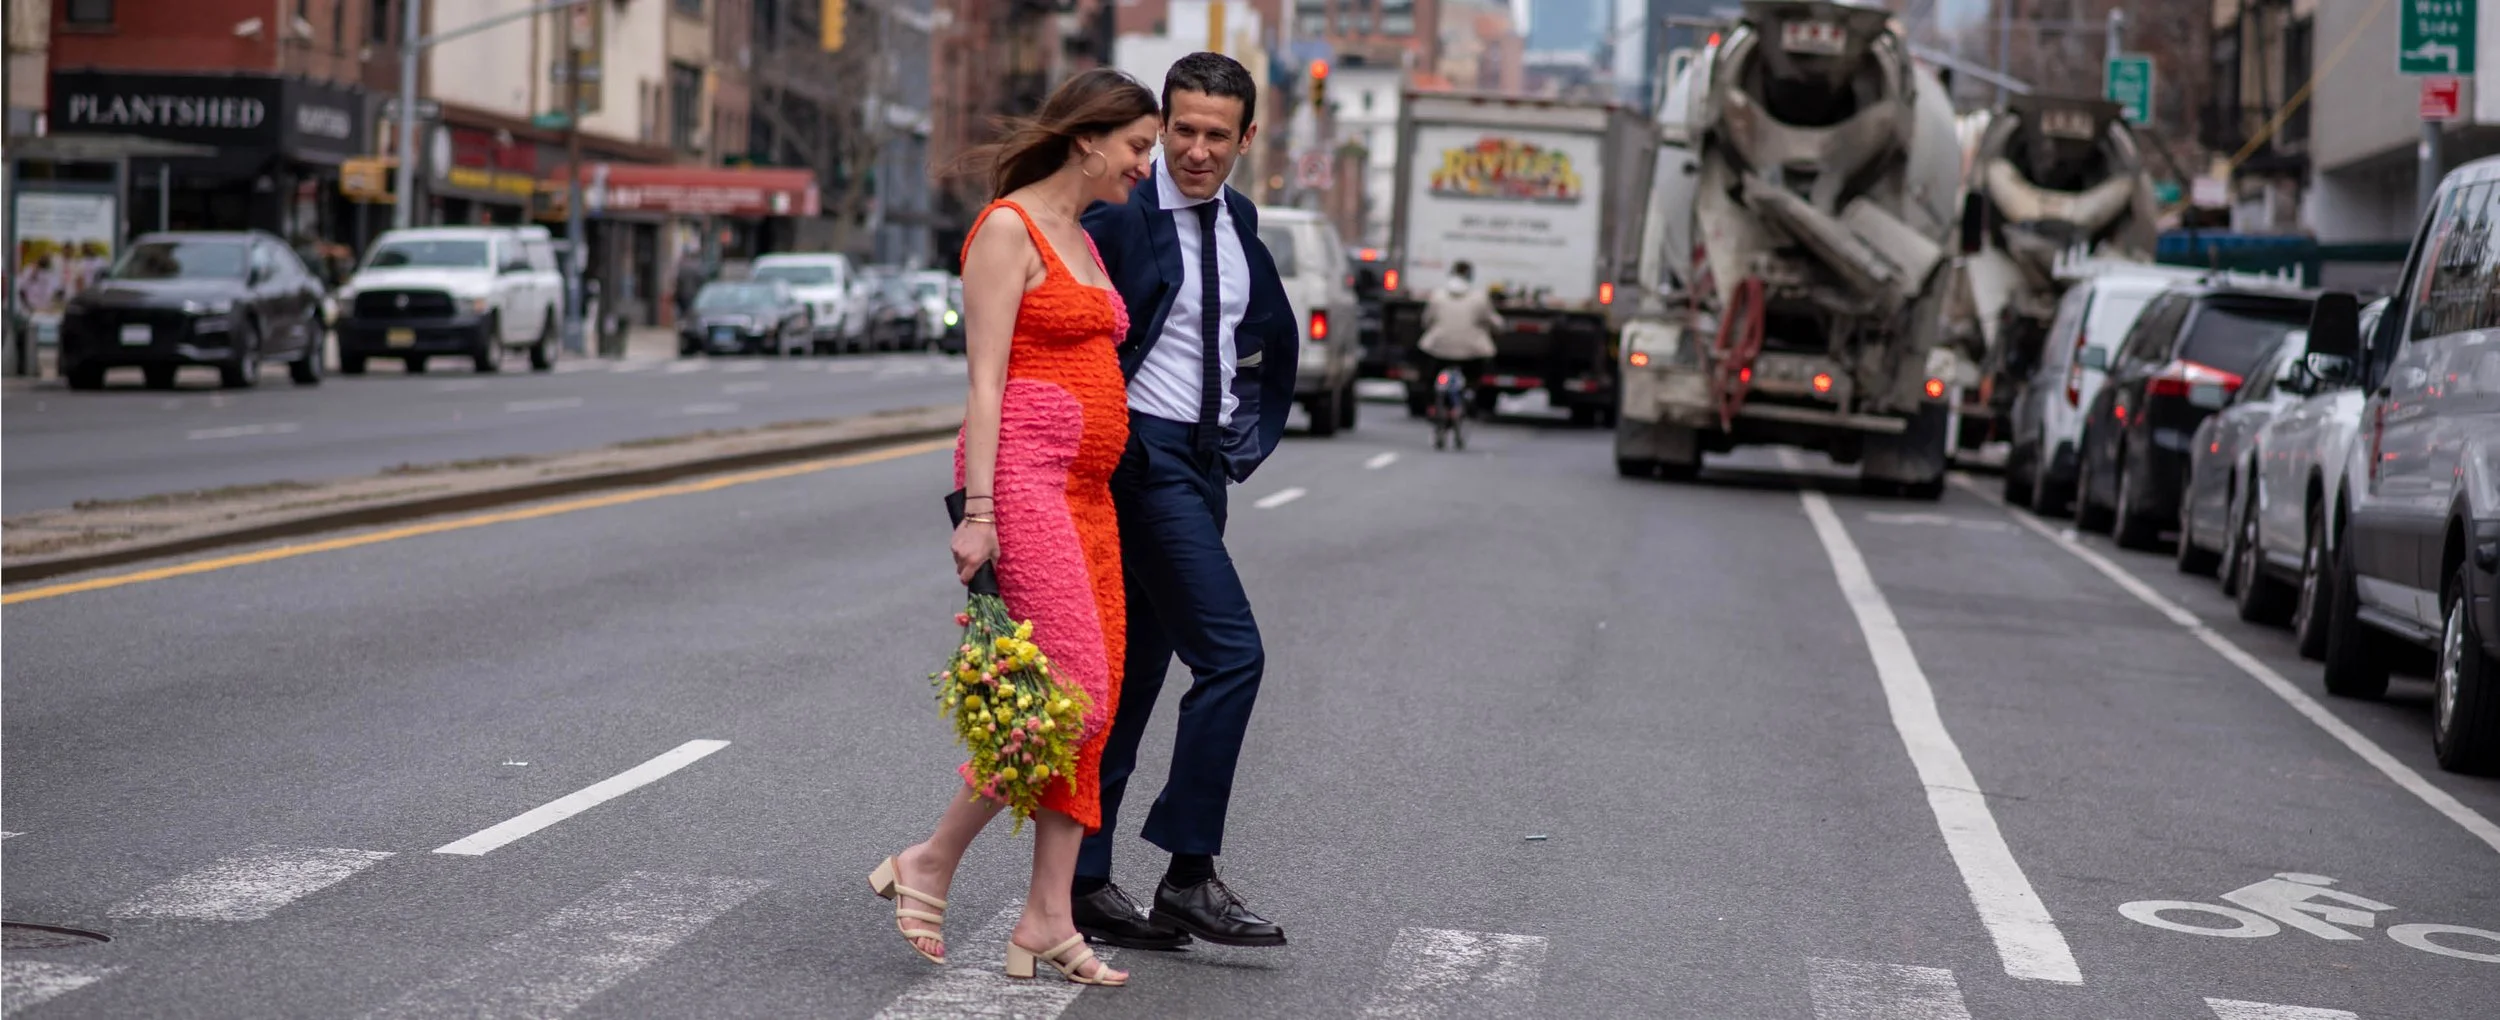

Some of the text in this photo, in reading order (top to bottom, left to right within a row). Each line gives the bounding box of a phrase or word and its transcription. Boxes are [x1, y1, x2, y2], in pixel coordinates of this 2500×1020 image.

[2415, 0, 2462, 16] West
[2419, 18, 2459, 36] Side
[68, 94, 265, 128] PLANTSHED
